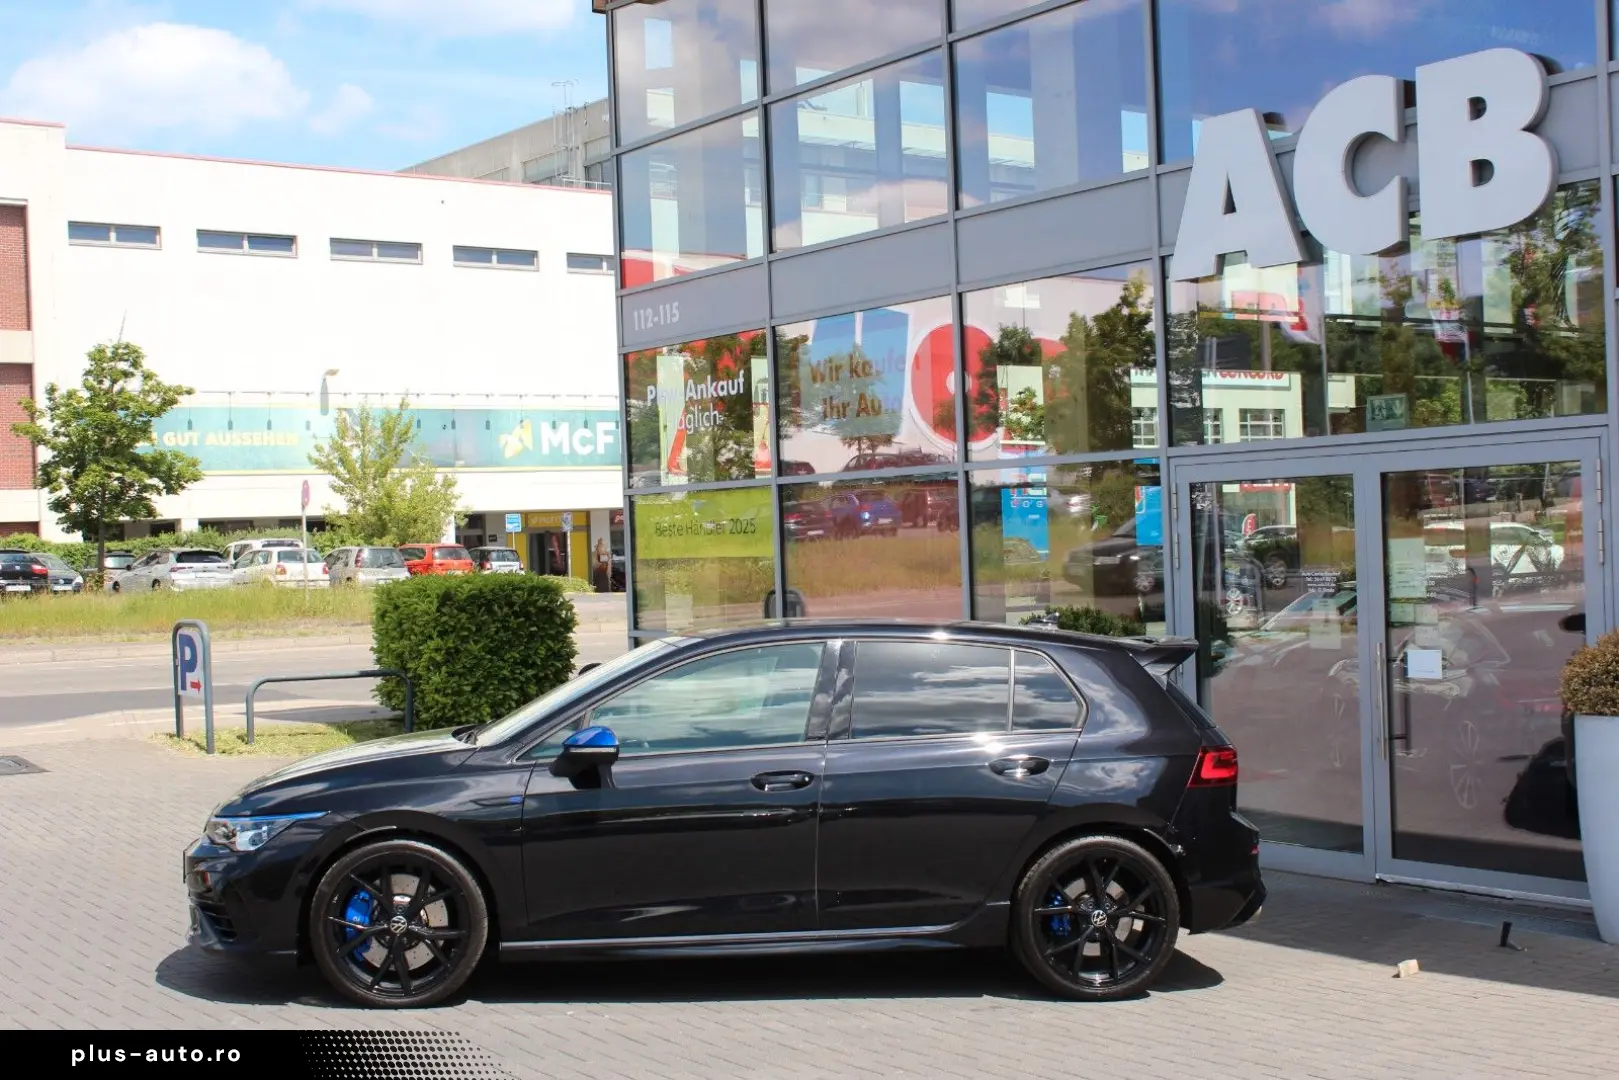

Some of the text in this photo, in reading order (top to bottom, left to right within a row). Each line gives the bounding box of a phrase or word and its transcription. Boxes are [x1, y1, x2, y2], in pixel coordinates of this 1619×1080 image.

[1169, 47, 1558, 282] ACB
[633, 301, 680, 331] 112-115
[822, 395, 850, 421] Ihr
[163, 431, 200, 447] GUT
[540, 421, 622, 455] McF
[655, 521, 684, 537] Beste
[729, 518, 756, 535] 2025
[178, 632, 198, 691] P
